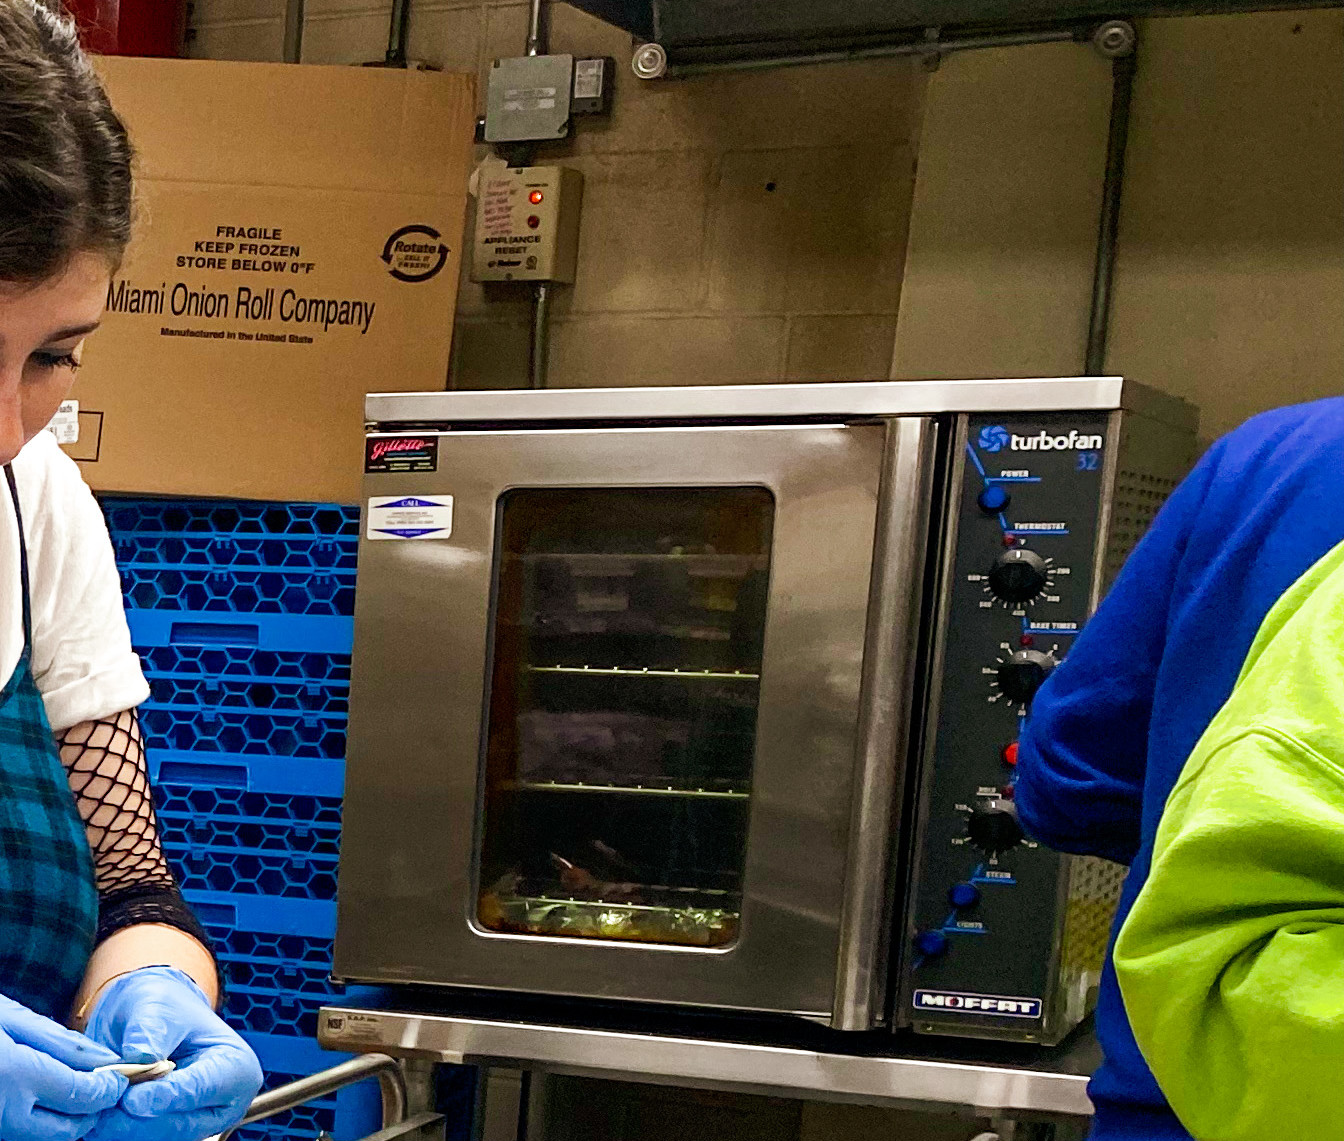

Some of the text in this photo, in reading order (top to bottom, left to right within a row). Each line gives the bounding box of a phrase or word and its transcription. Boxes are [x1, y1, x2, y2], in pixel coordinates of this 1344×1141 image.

[216, 225, 282, 241] FRAGILE
[194, 241, 301, 258] KEEP FROZEN
[394, 241, 437, 254] Rotate
[176, 255, 227, 270] STORE
[231, 258, 287, 273] BELOW
[105, 280, 376, 335] Miami Onion Roll Company
[160, 327, 225, 340] Manufactured
[226, 331, 236, 340] in
[238, 331, 254, 341] the
[255, 332, 286, 343] United
[1010, 430, 1103, 451] turbofan
[1076, 452, 1099, 471] 32
[1000, 469, 1030, 478] POWER
[921, 993, 1036, 1013] MOFFAT
